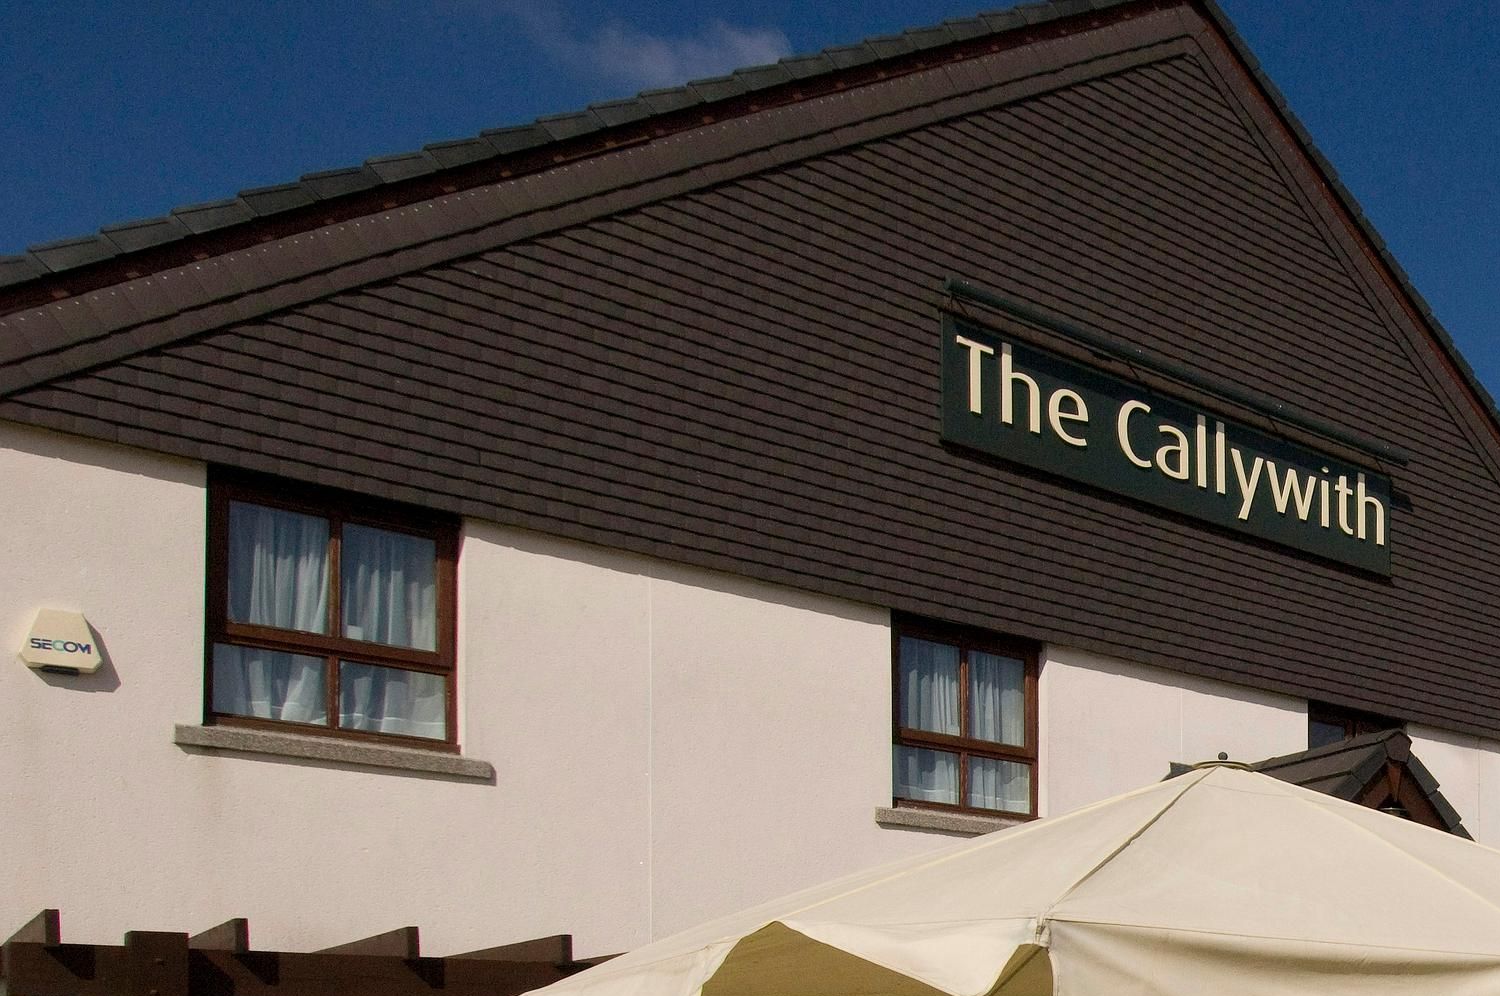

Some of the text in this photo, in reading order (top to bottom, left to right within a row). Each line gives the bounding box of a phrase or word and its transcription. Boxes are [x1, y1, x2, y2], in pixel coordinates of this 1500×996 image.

[956, 335, 1385, 546] The Callywith
[30, 638, 92, 654] SECOM
